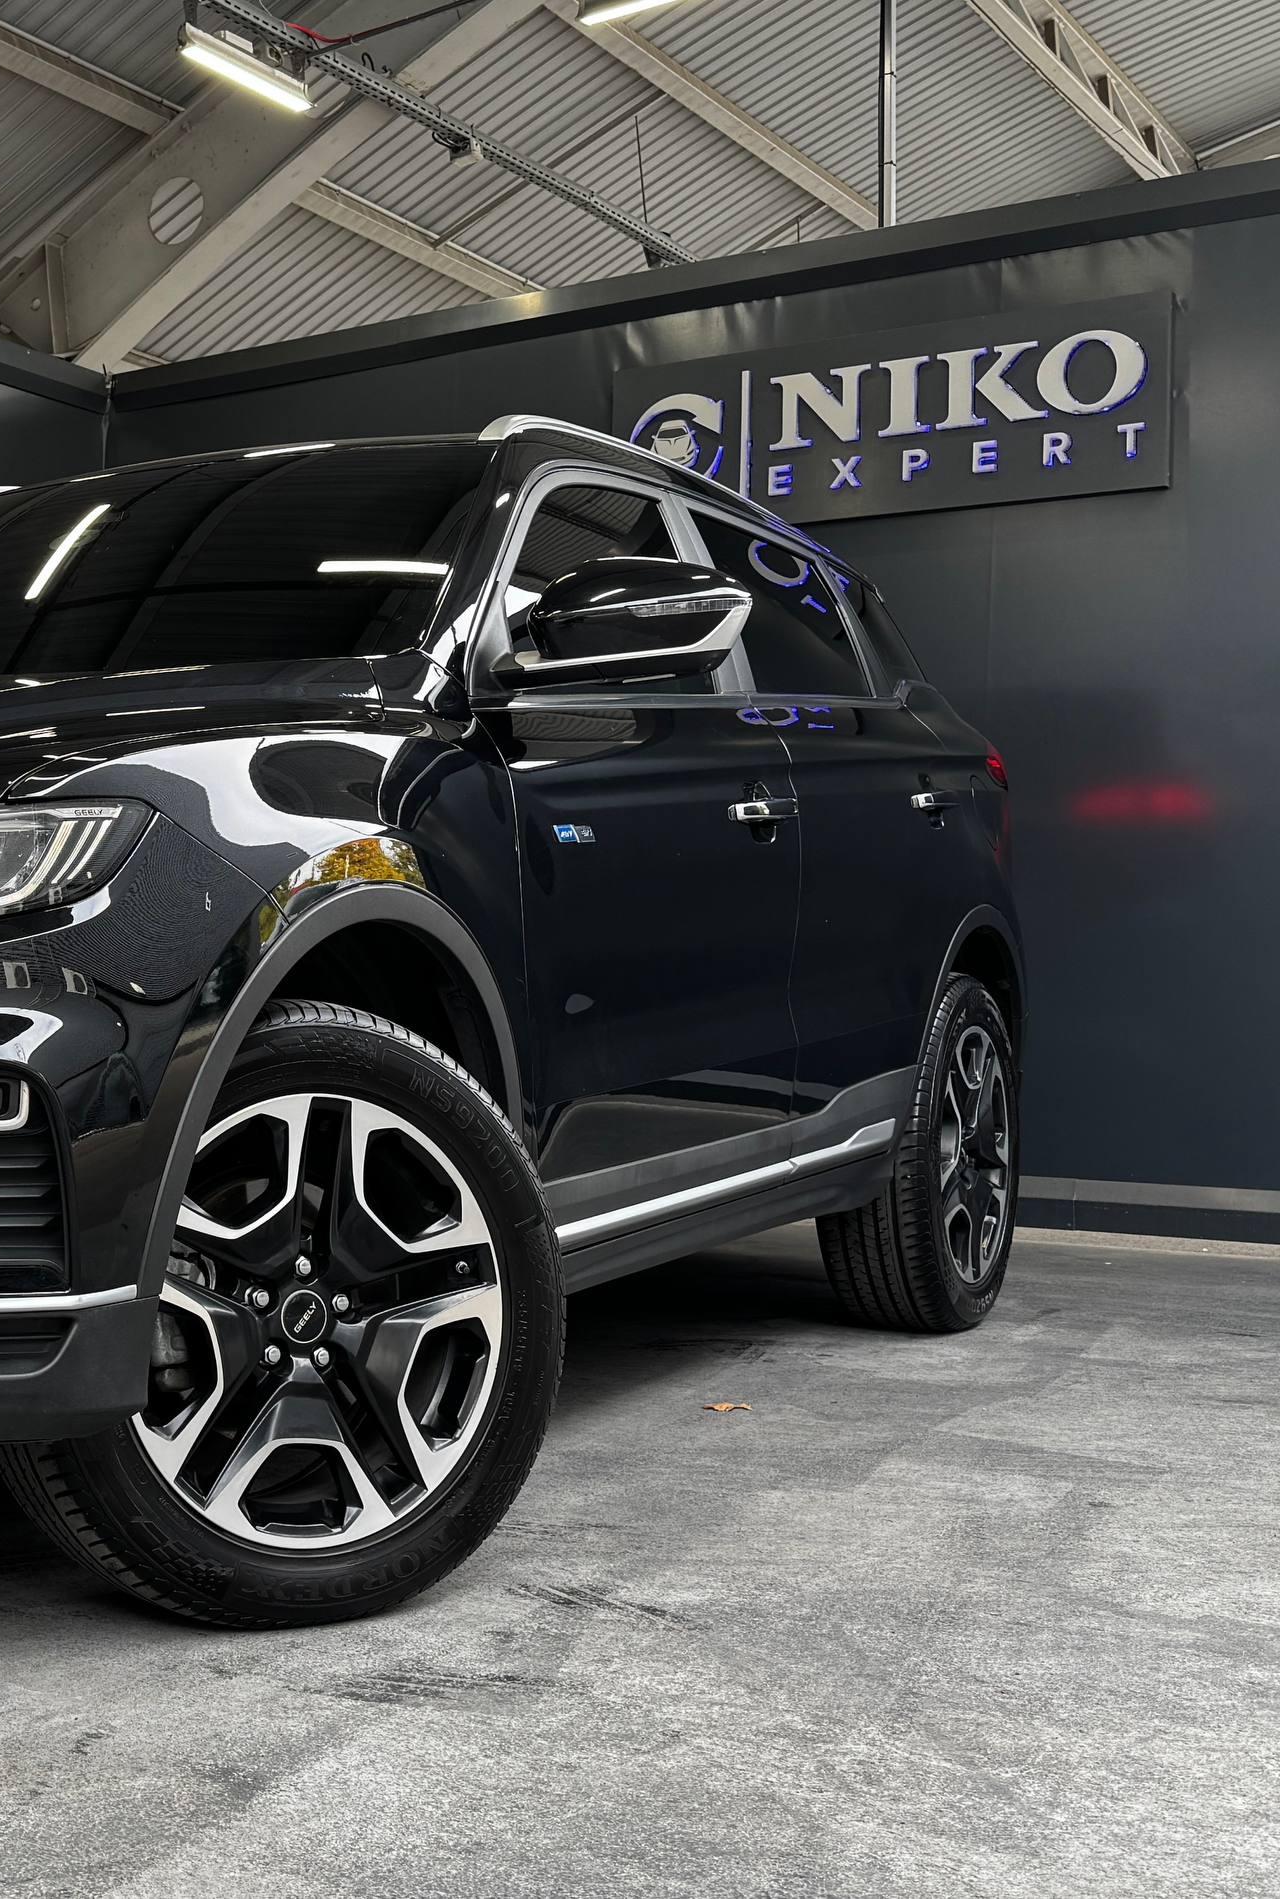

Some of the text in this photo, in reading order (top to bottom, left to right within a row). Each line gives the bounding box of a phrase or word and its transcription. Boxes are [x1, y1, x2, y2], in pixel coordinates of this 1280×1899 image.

[769, 329, 1148, 452] NIKO
[767, 421, 1146, 497] EXPERT
[74, 808, 103, 817] GEELY
[292, 1300, 318, 1335] GEELY
